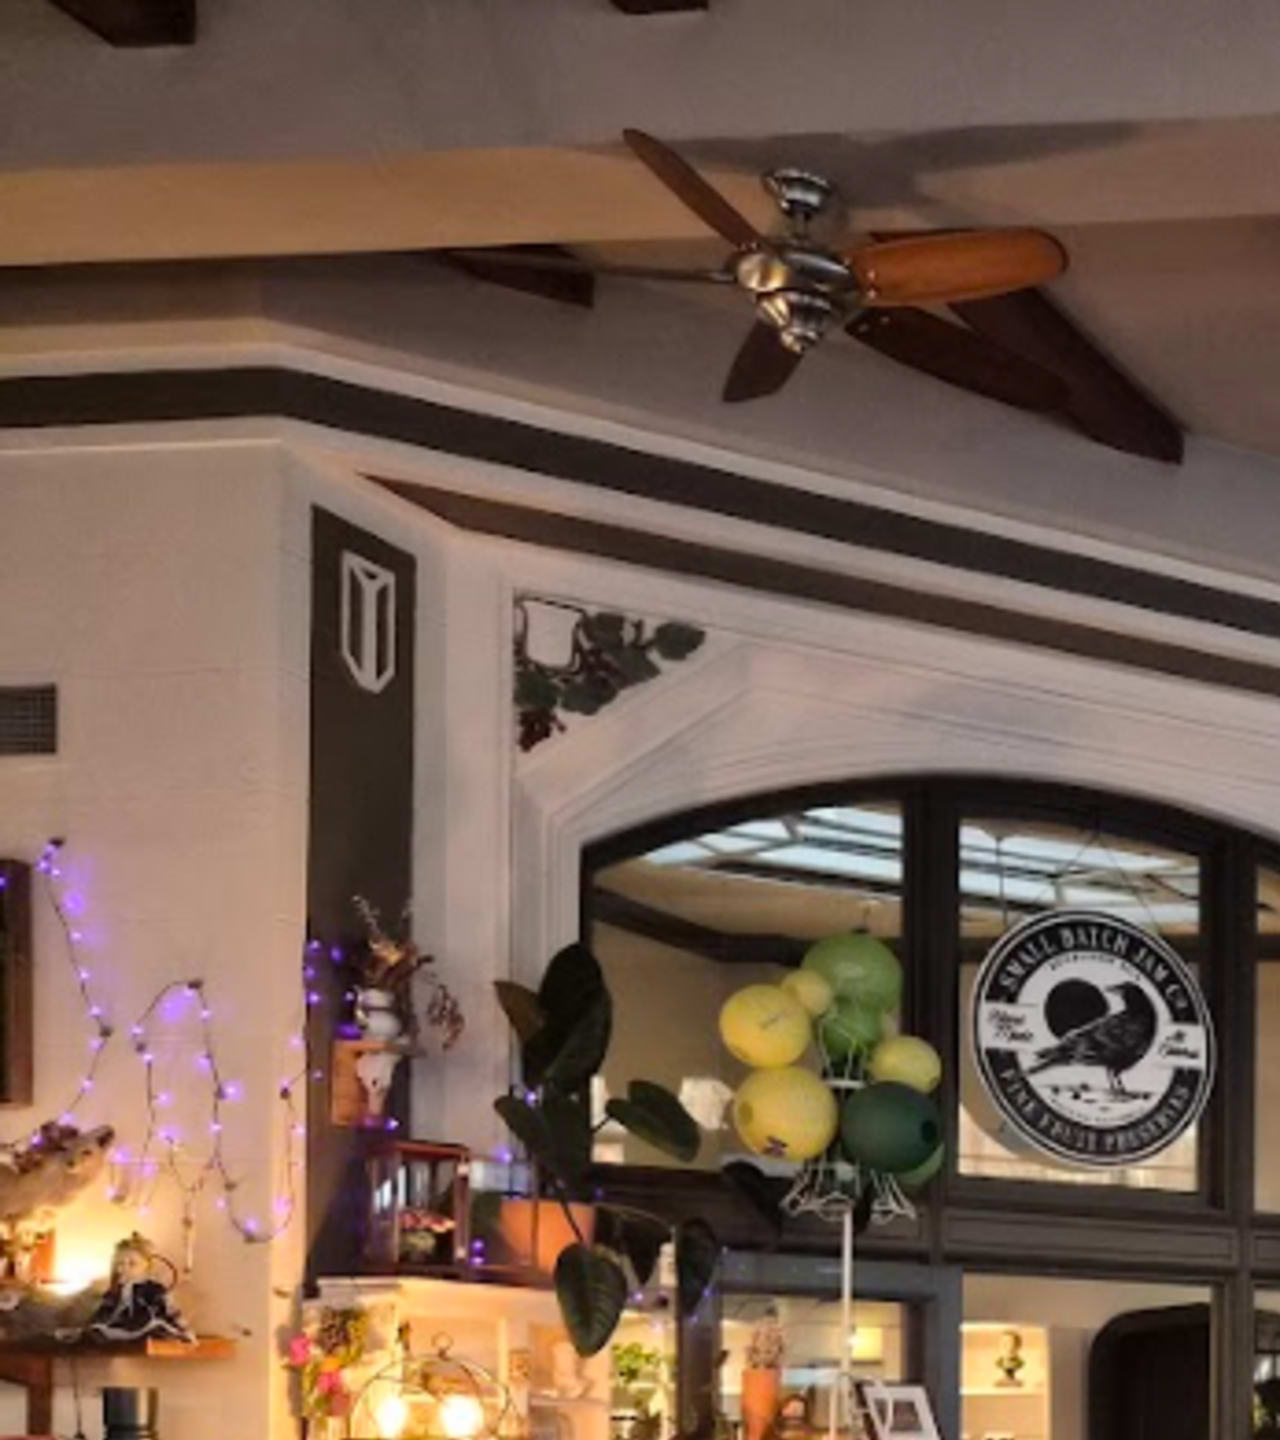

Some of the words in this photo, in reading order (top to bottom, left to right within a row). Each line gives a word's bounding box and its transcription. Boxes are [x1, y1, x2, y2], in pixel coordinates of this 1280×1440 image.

[1000, 934, 1058, 992] SMALL
[1060, 926, 1129, 956] BATCH
[1133, 947, 1170, 981] JAM
